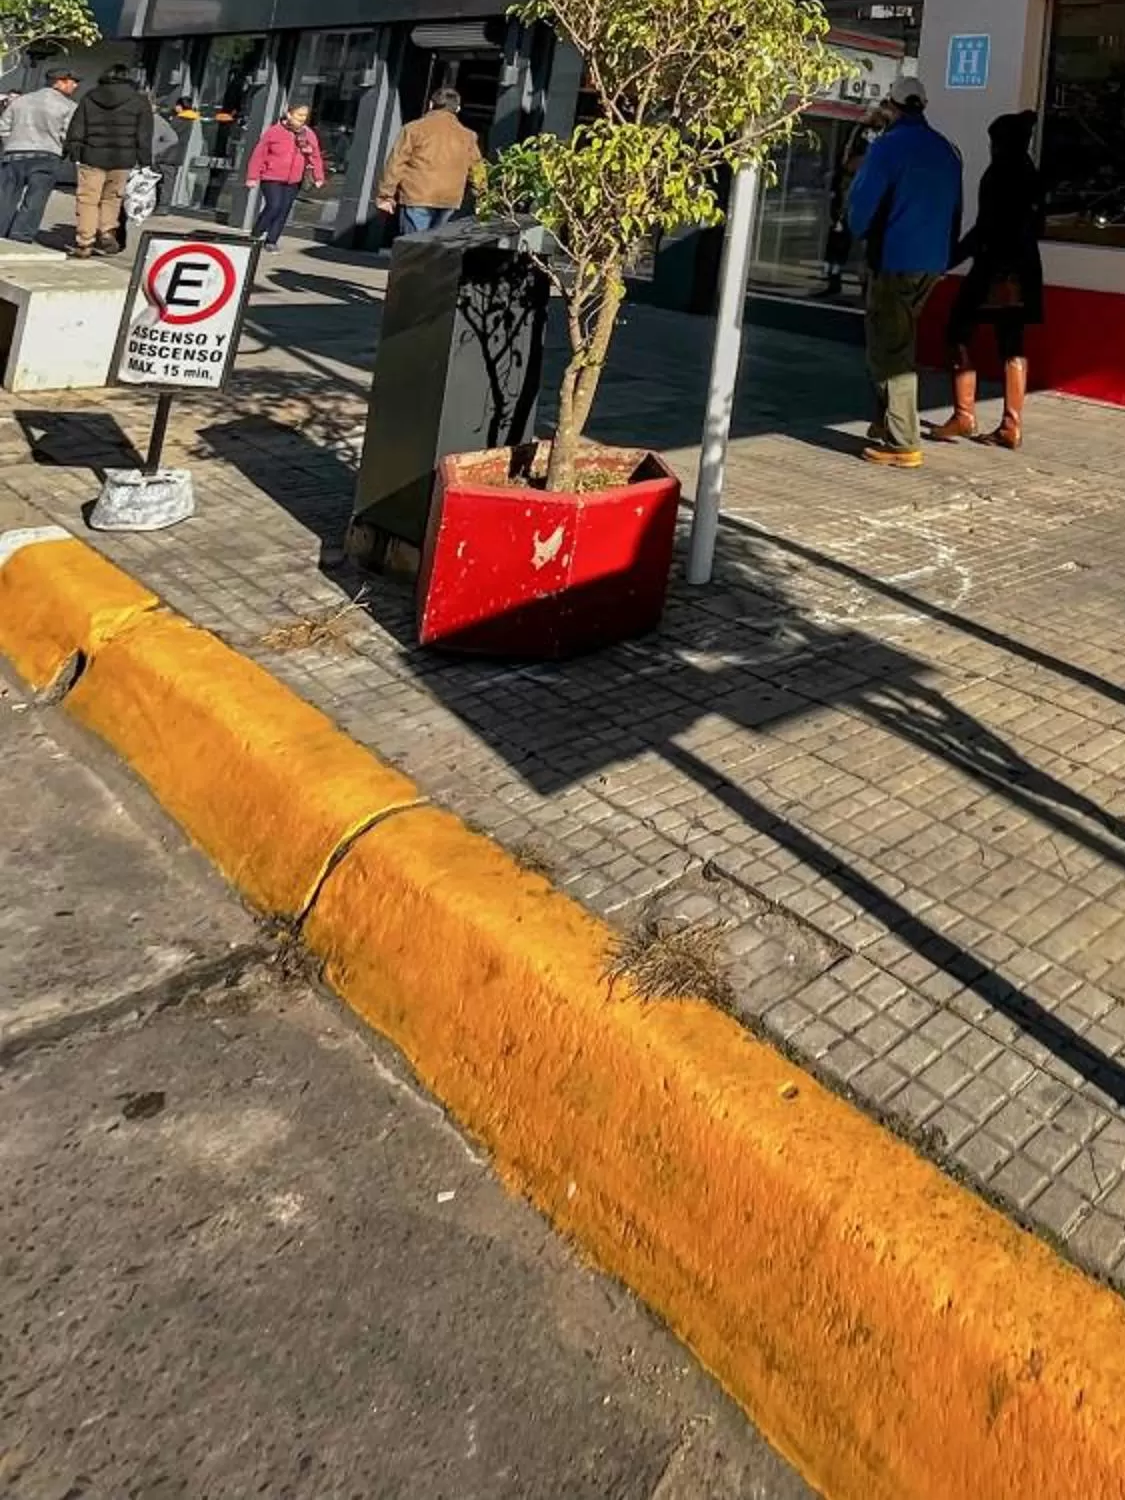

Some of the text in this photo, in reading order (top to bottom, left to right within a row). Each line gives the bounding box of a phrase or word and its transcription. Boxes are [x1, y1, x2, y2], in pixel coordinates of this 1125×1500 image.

[957, 50, 979, 73] H
[165, 261, 210, 307] E
[131, 325, 226, 347] ASCENSO Y
[128, 342, 223, 363] DESCENSO
[163, 364, 179, 377] 15
[184, 367, 214, 379] min.
